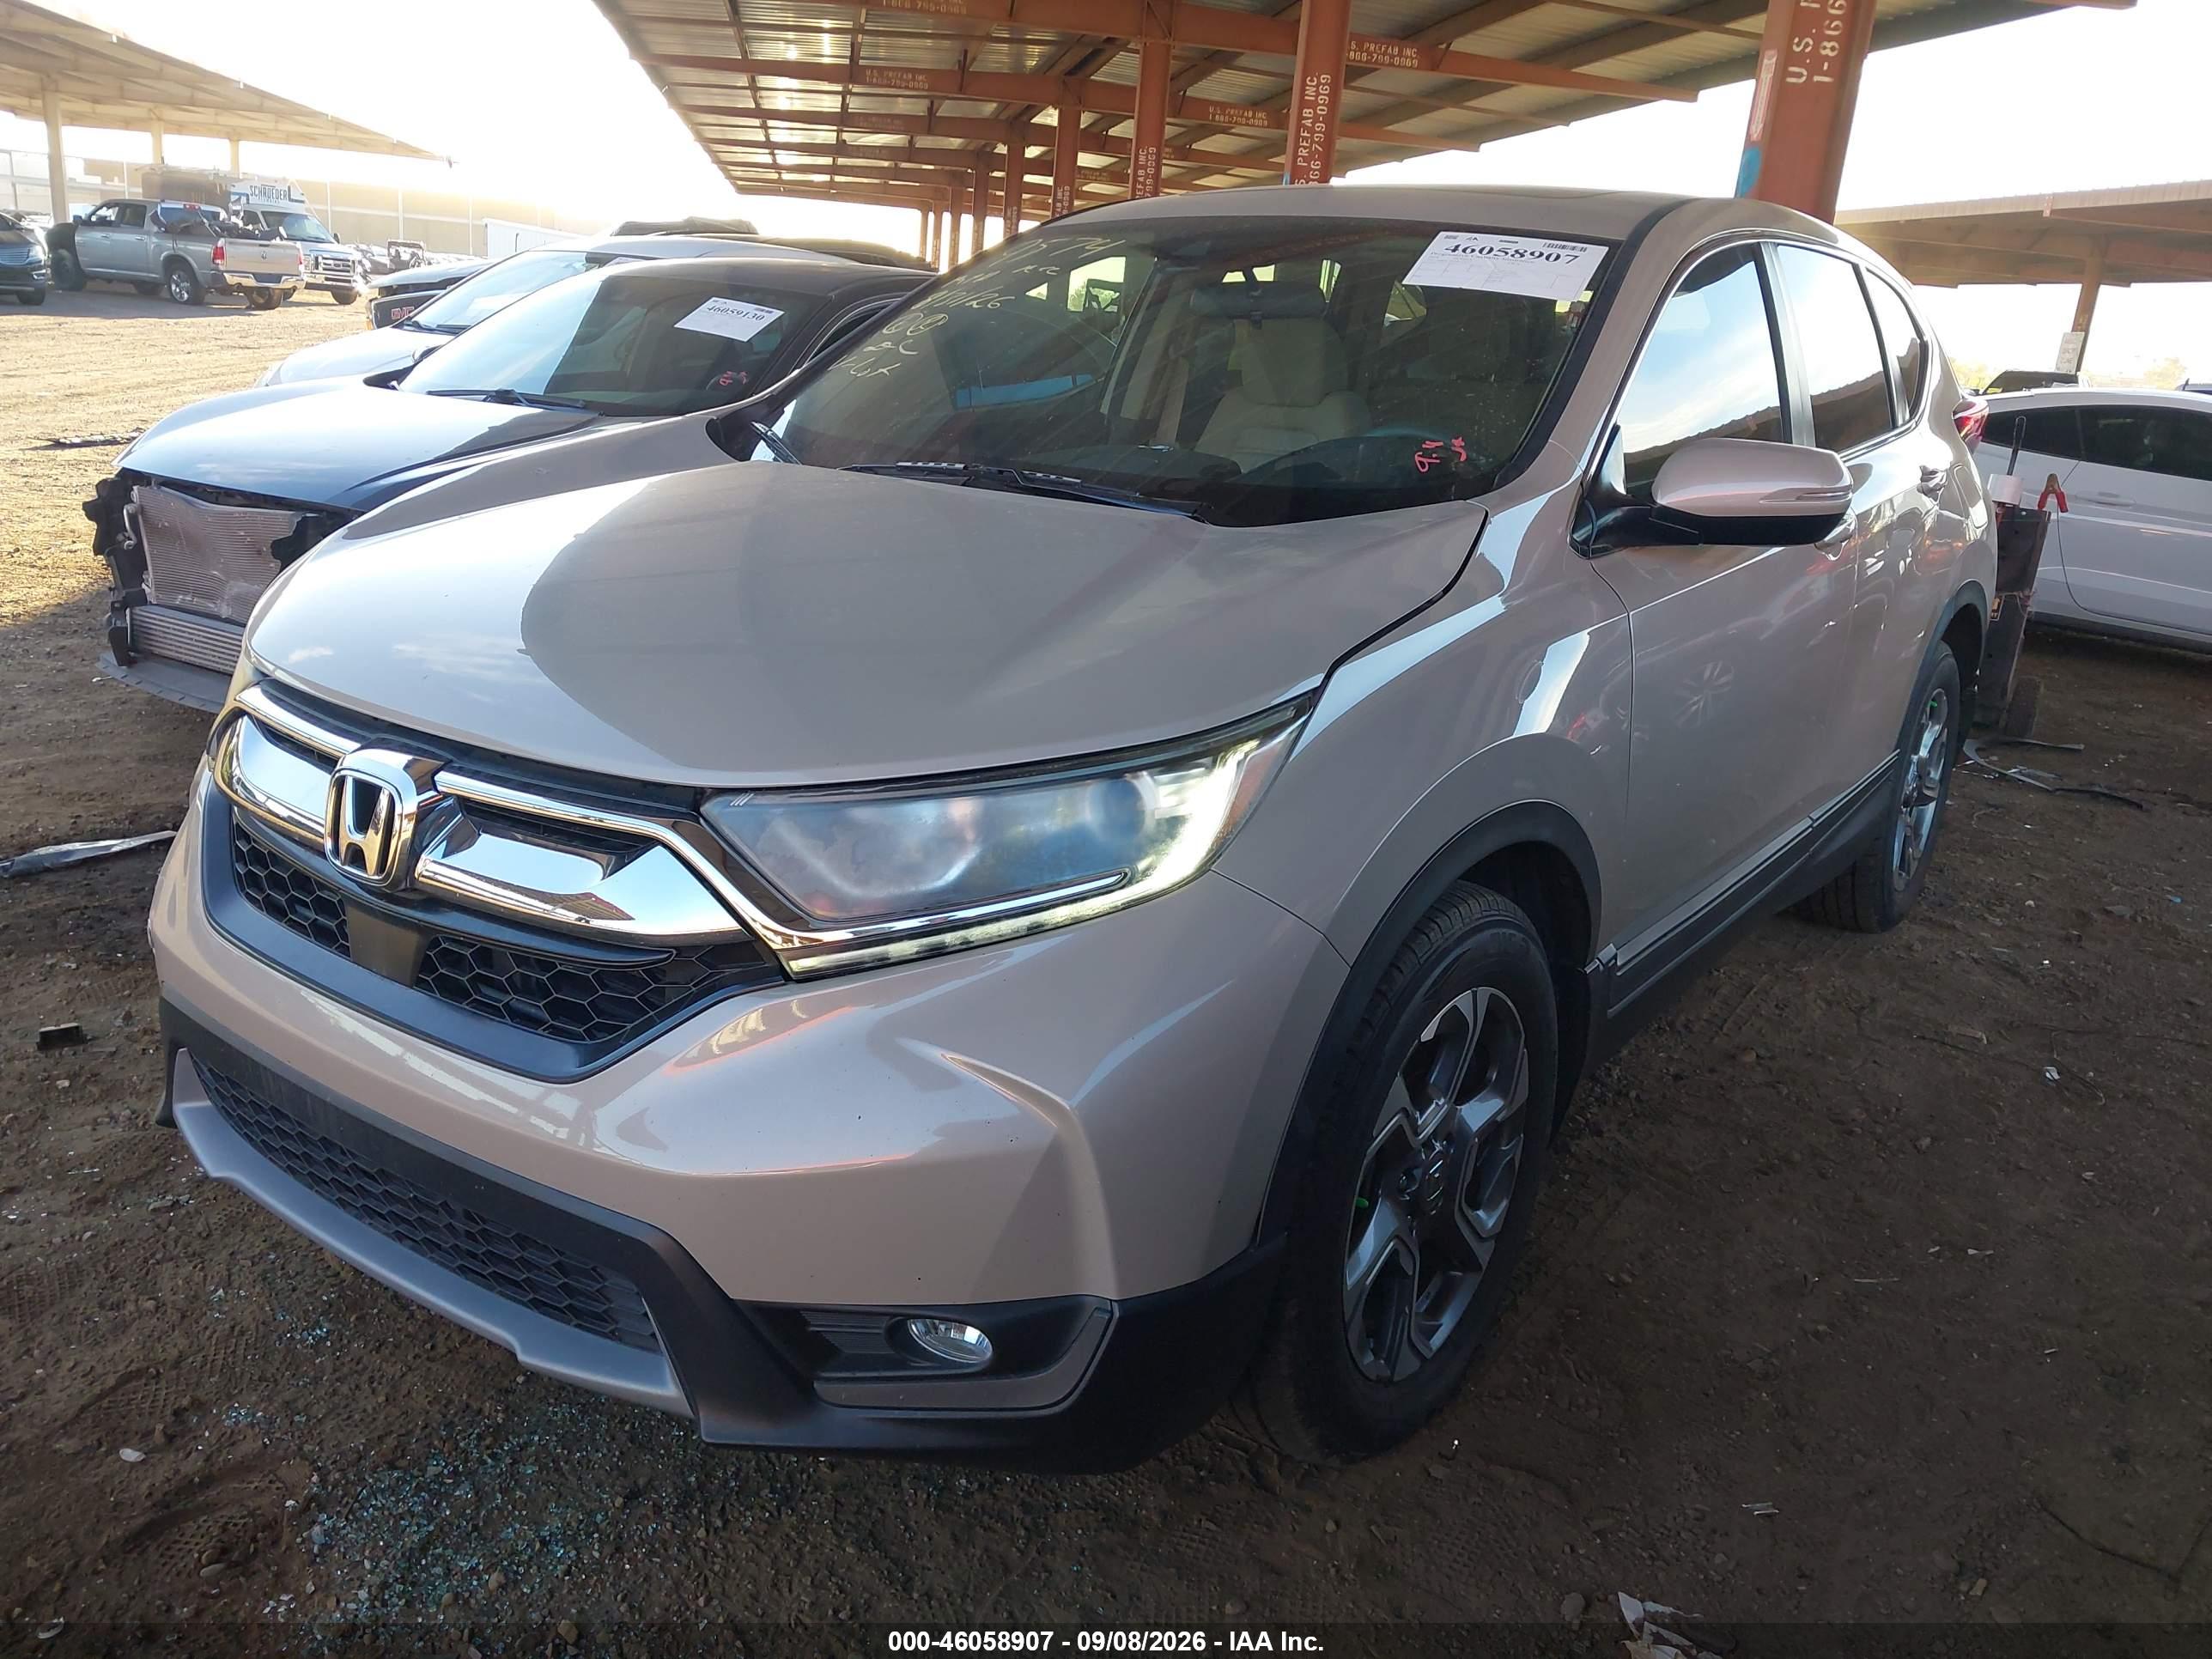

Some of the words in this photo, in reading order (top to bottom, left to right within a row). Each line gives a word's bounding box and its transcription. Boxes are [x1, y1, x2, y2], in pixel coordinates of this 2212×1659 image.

[1363, 41, 1399, 56] PREFAB
[1786, 37, 1814, 83] U.S.
[1304, 72, 1319, 100] INC.
[1297, 107, 1314, 167] PREFAB
[249, 185, 289, 201] SCHROEDER
[1444, 243, 1581, 265] 46058907
[391, 306, 415, 320] GMC
[706, 304, 766, 322] 46059130
